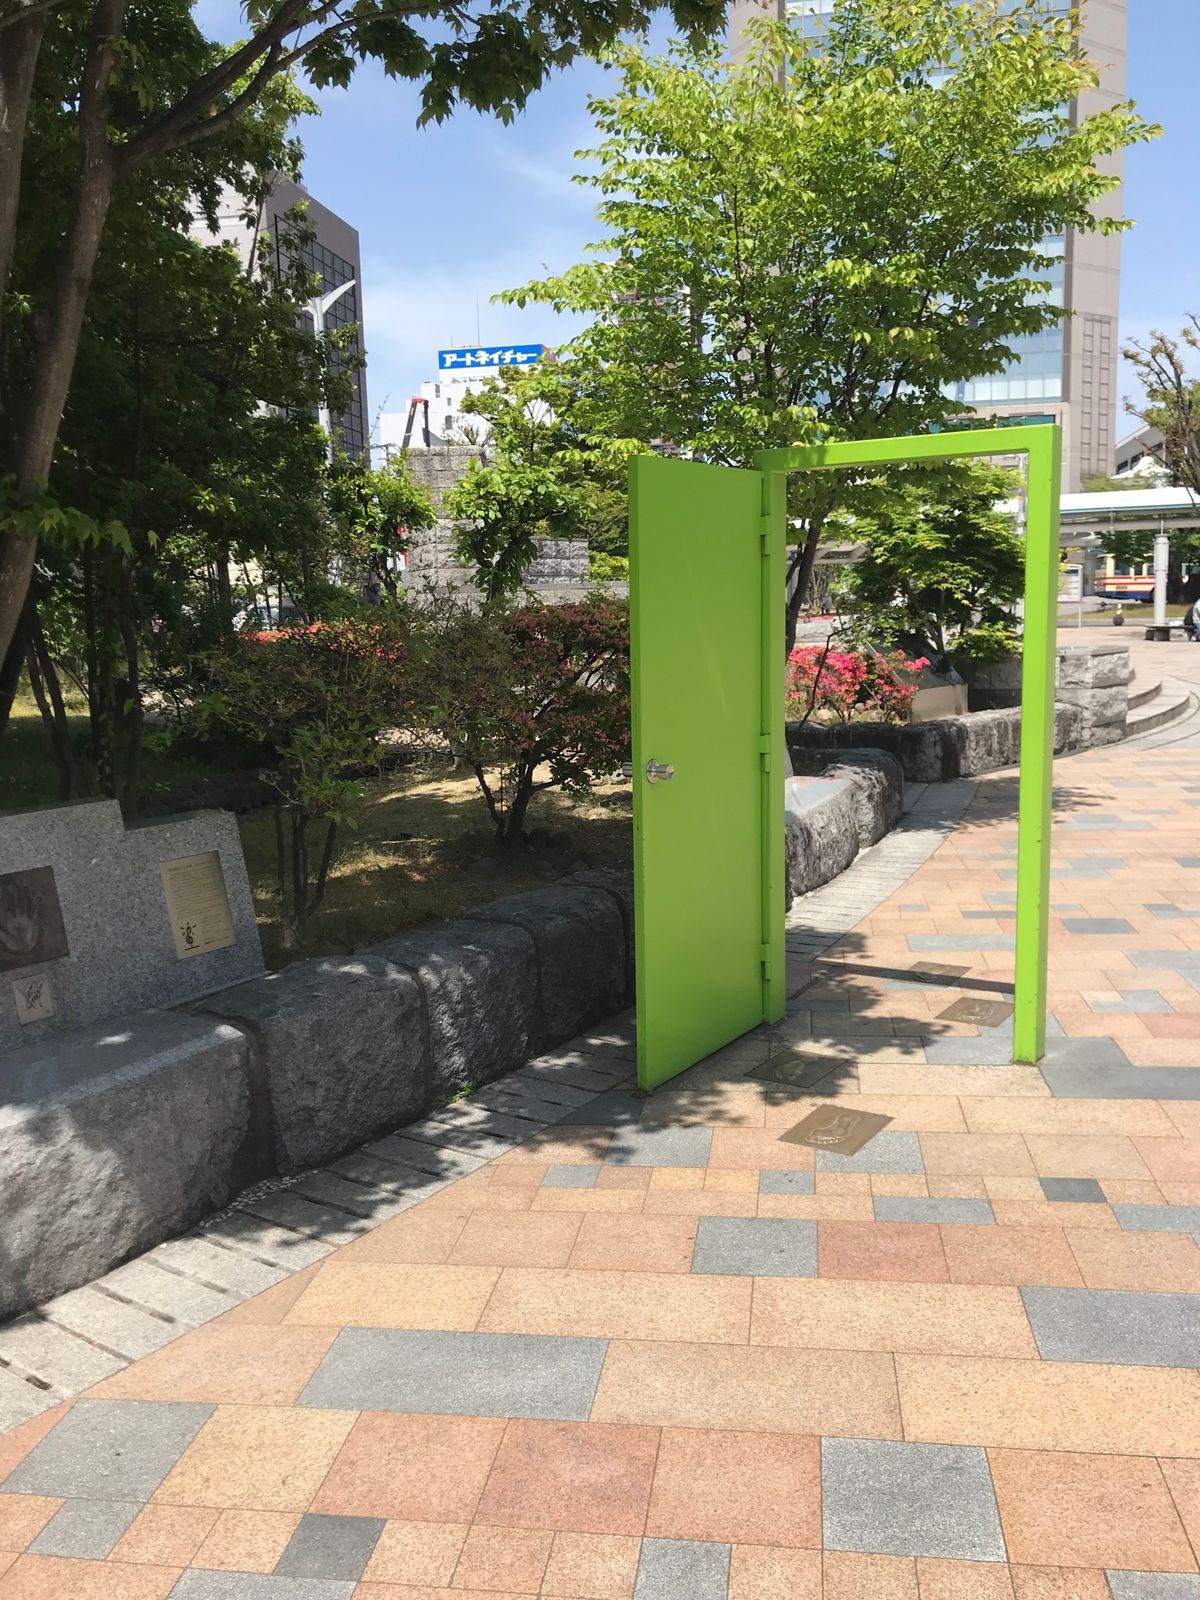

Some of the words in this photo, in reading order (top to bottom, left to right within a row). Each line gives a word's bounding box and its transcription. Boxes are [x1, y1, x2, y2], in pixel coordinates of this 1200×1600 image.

[443, 349, 537, 367] アートネイチャー
